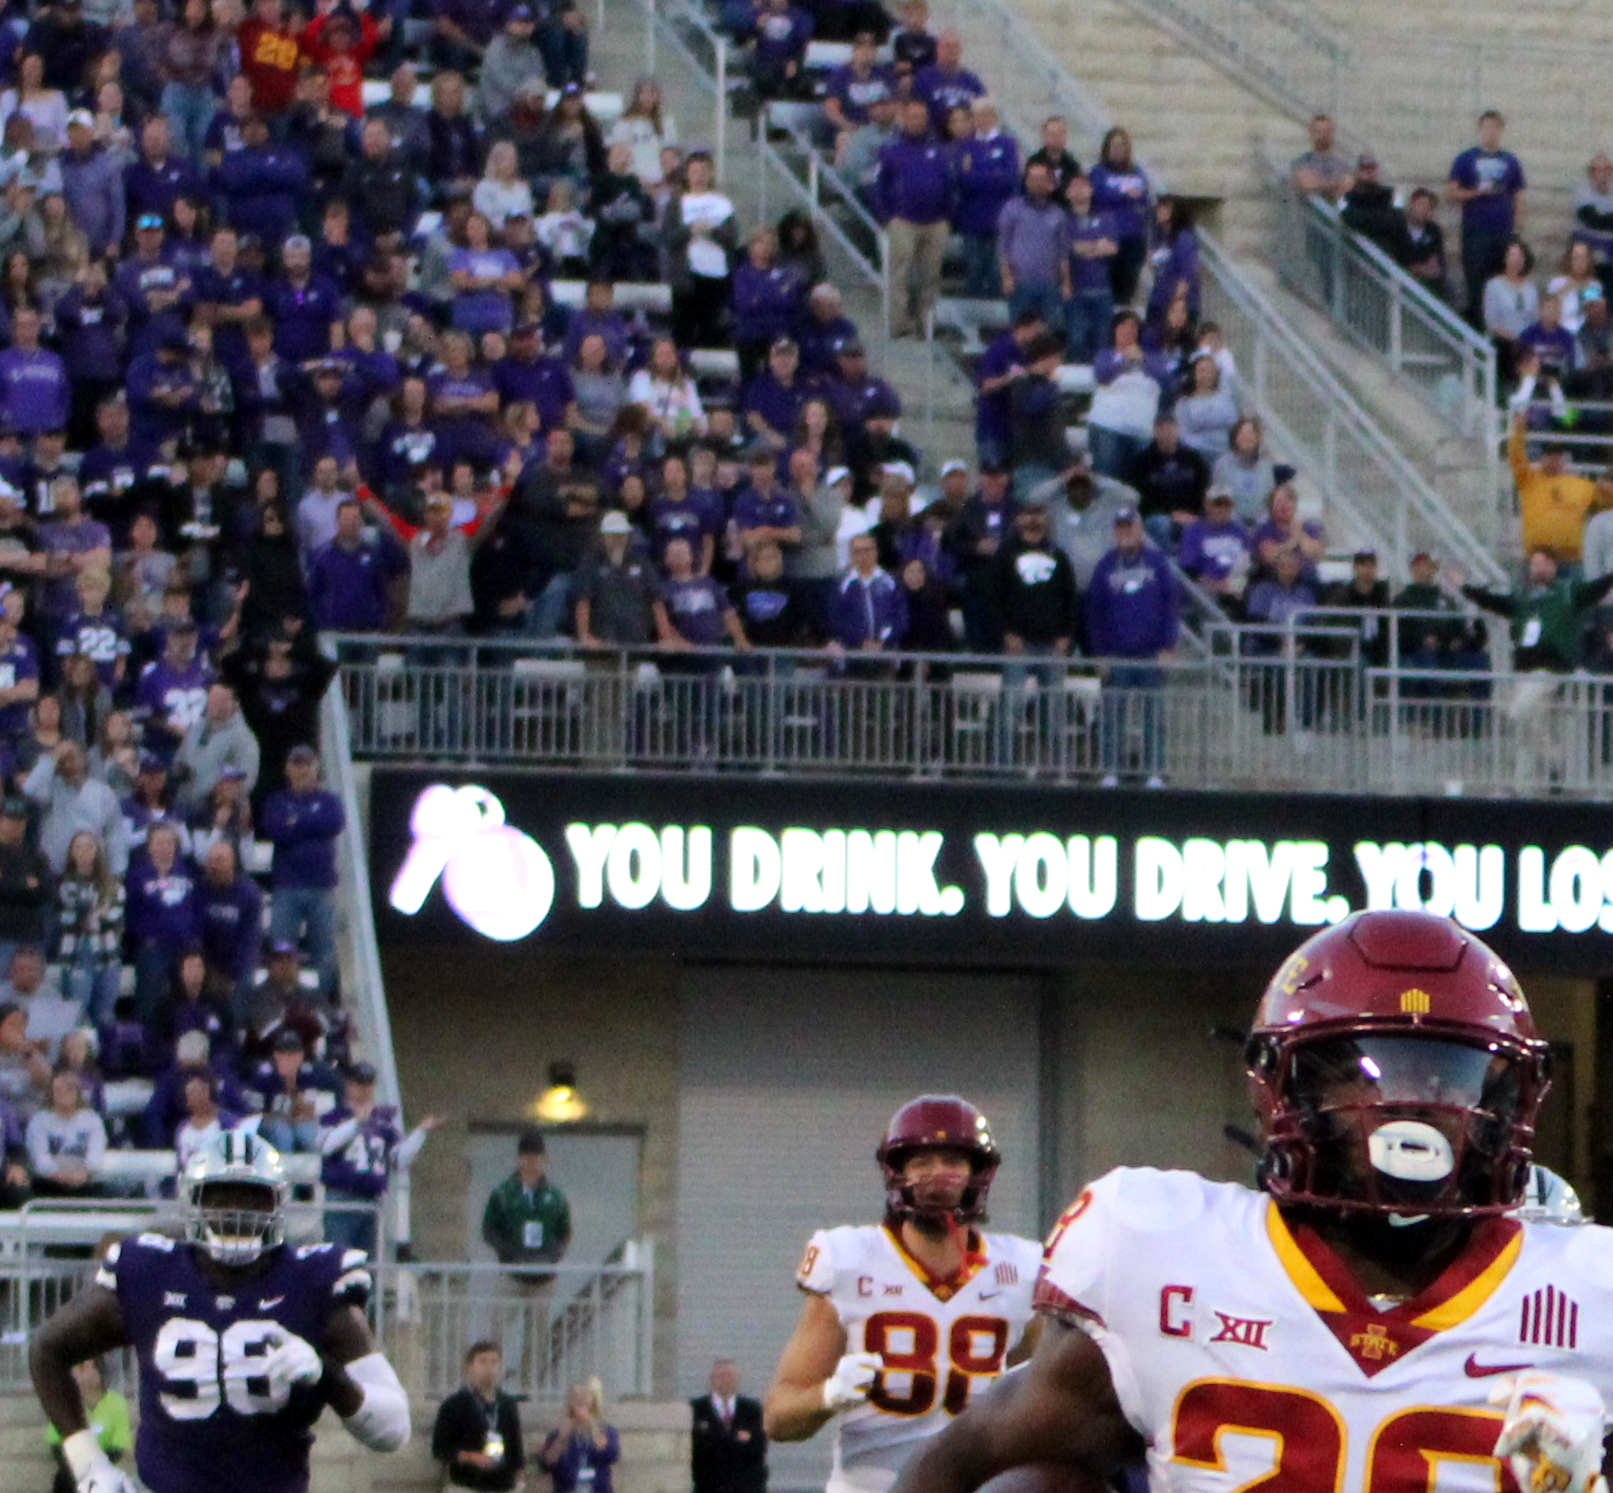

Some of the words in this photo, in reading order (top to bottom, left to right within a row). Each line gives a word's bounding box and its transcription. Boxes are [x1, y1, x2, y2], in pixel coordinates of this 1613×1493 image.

[565, 824, 713, 912] YOU
[730, 828, 966, 916] DRINK.
[975, 834, 1118, 920] YOU
[1134, 837, 1350, 925] DRIVE.
[1353, 842, 1506, 932] YOU
[1160, 1284, 1194, 1338] C
[1209, 1310, 1274, 1351] XII
